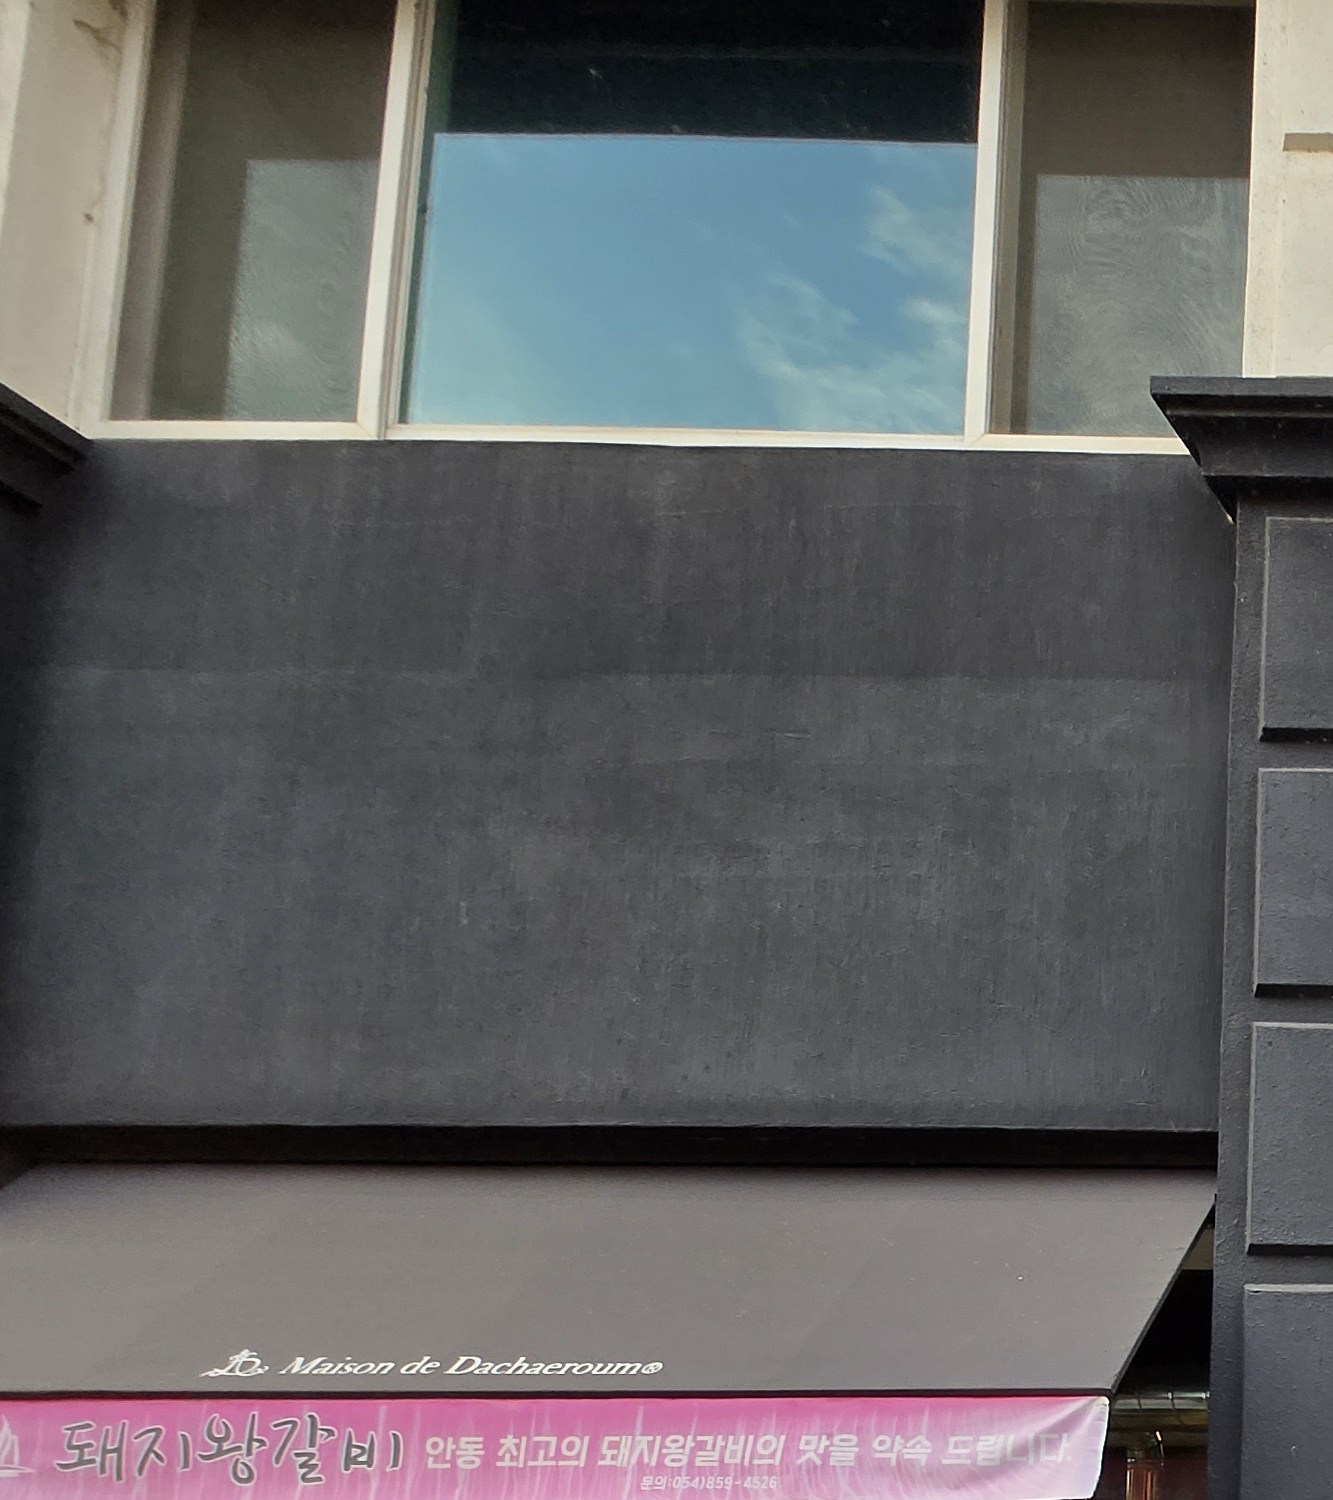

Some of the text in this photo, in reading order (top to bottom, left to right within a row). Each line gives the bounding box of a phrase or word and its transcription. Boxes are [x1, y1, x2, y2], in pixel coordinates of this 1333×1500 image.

[279, 1356, 395, 1375] Maison
[400, 1356, 440, 1375] de
[55, 1411, 405, 1486] 돼지왕갈비
[425, 1436, 486, 1469] 안동
[496, 1434, 589, 1468] 최고의
[597, 1434, 785, 1467] 돼지왕갈비의
[796, 1434, 860, 1467] 맛을
[872, 1433, 932, 1467] 약속
